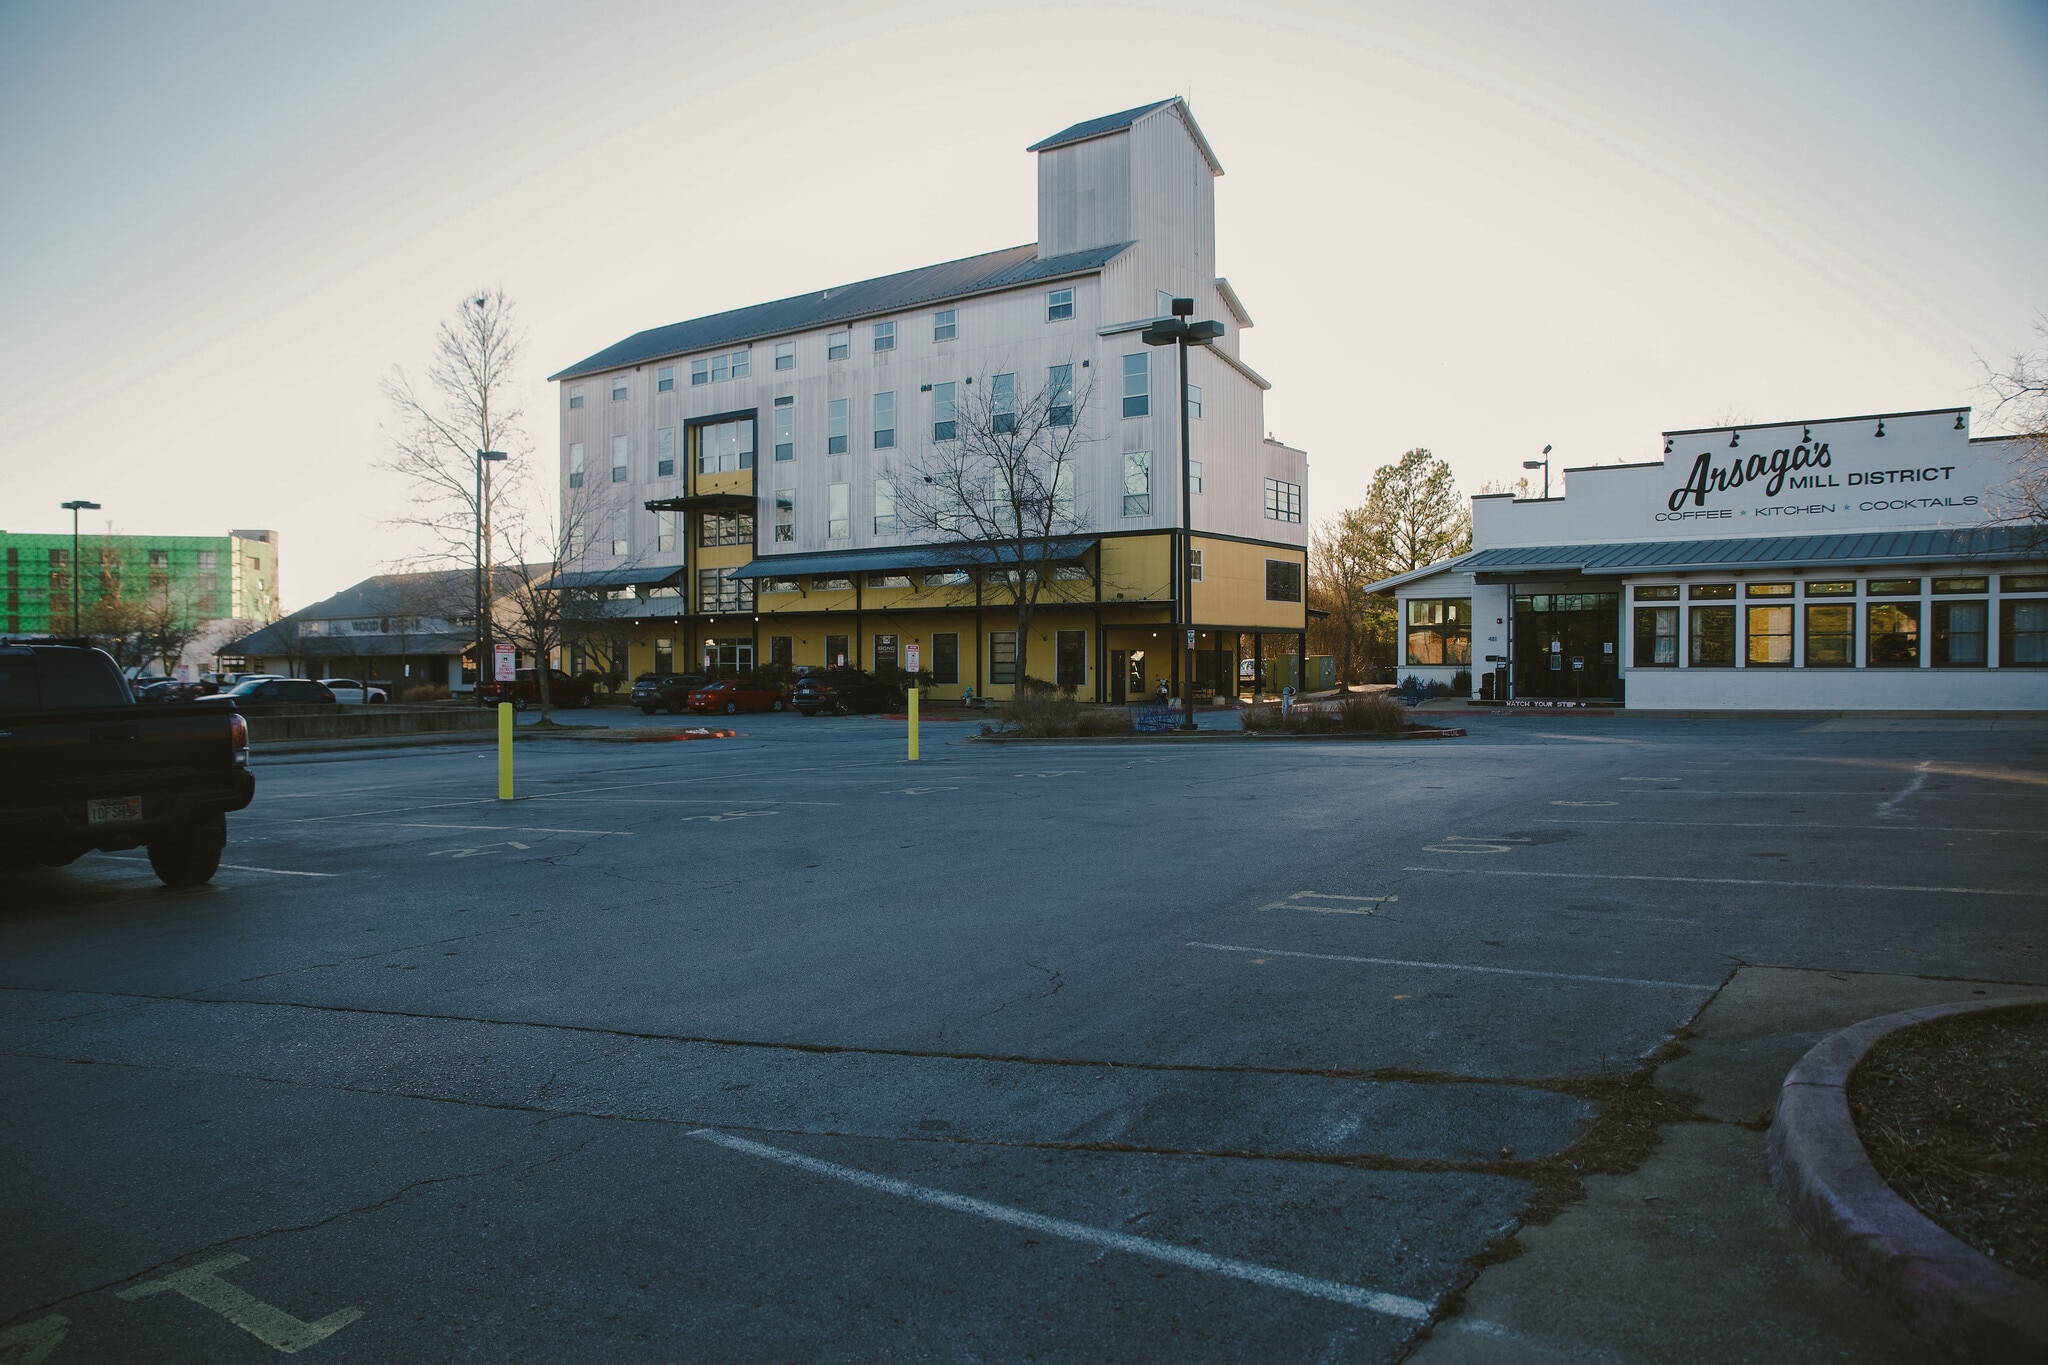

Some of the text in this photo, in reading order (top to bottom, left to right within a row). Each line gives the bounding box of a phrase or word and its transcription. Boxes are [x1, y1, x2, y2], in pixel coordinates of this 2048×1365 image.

[1668, 442, 1832, 511] Arsaga's
[1789, 466, 1955, 490] MILL DISTRICT
[1655, 495, 1979, 522] COFFEE KITCHEN COCKTAILS
